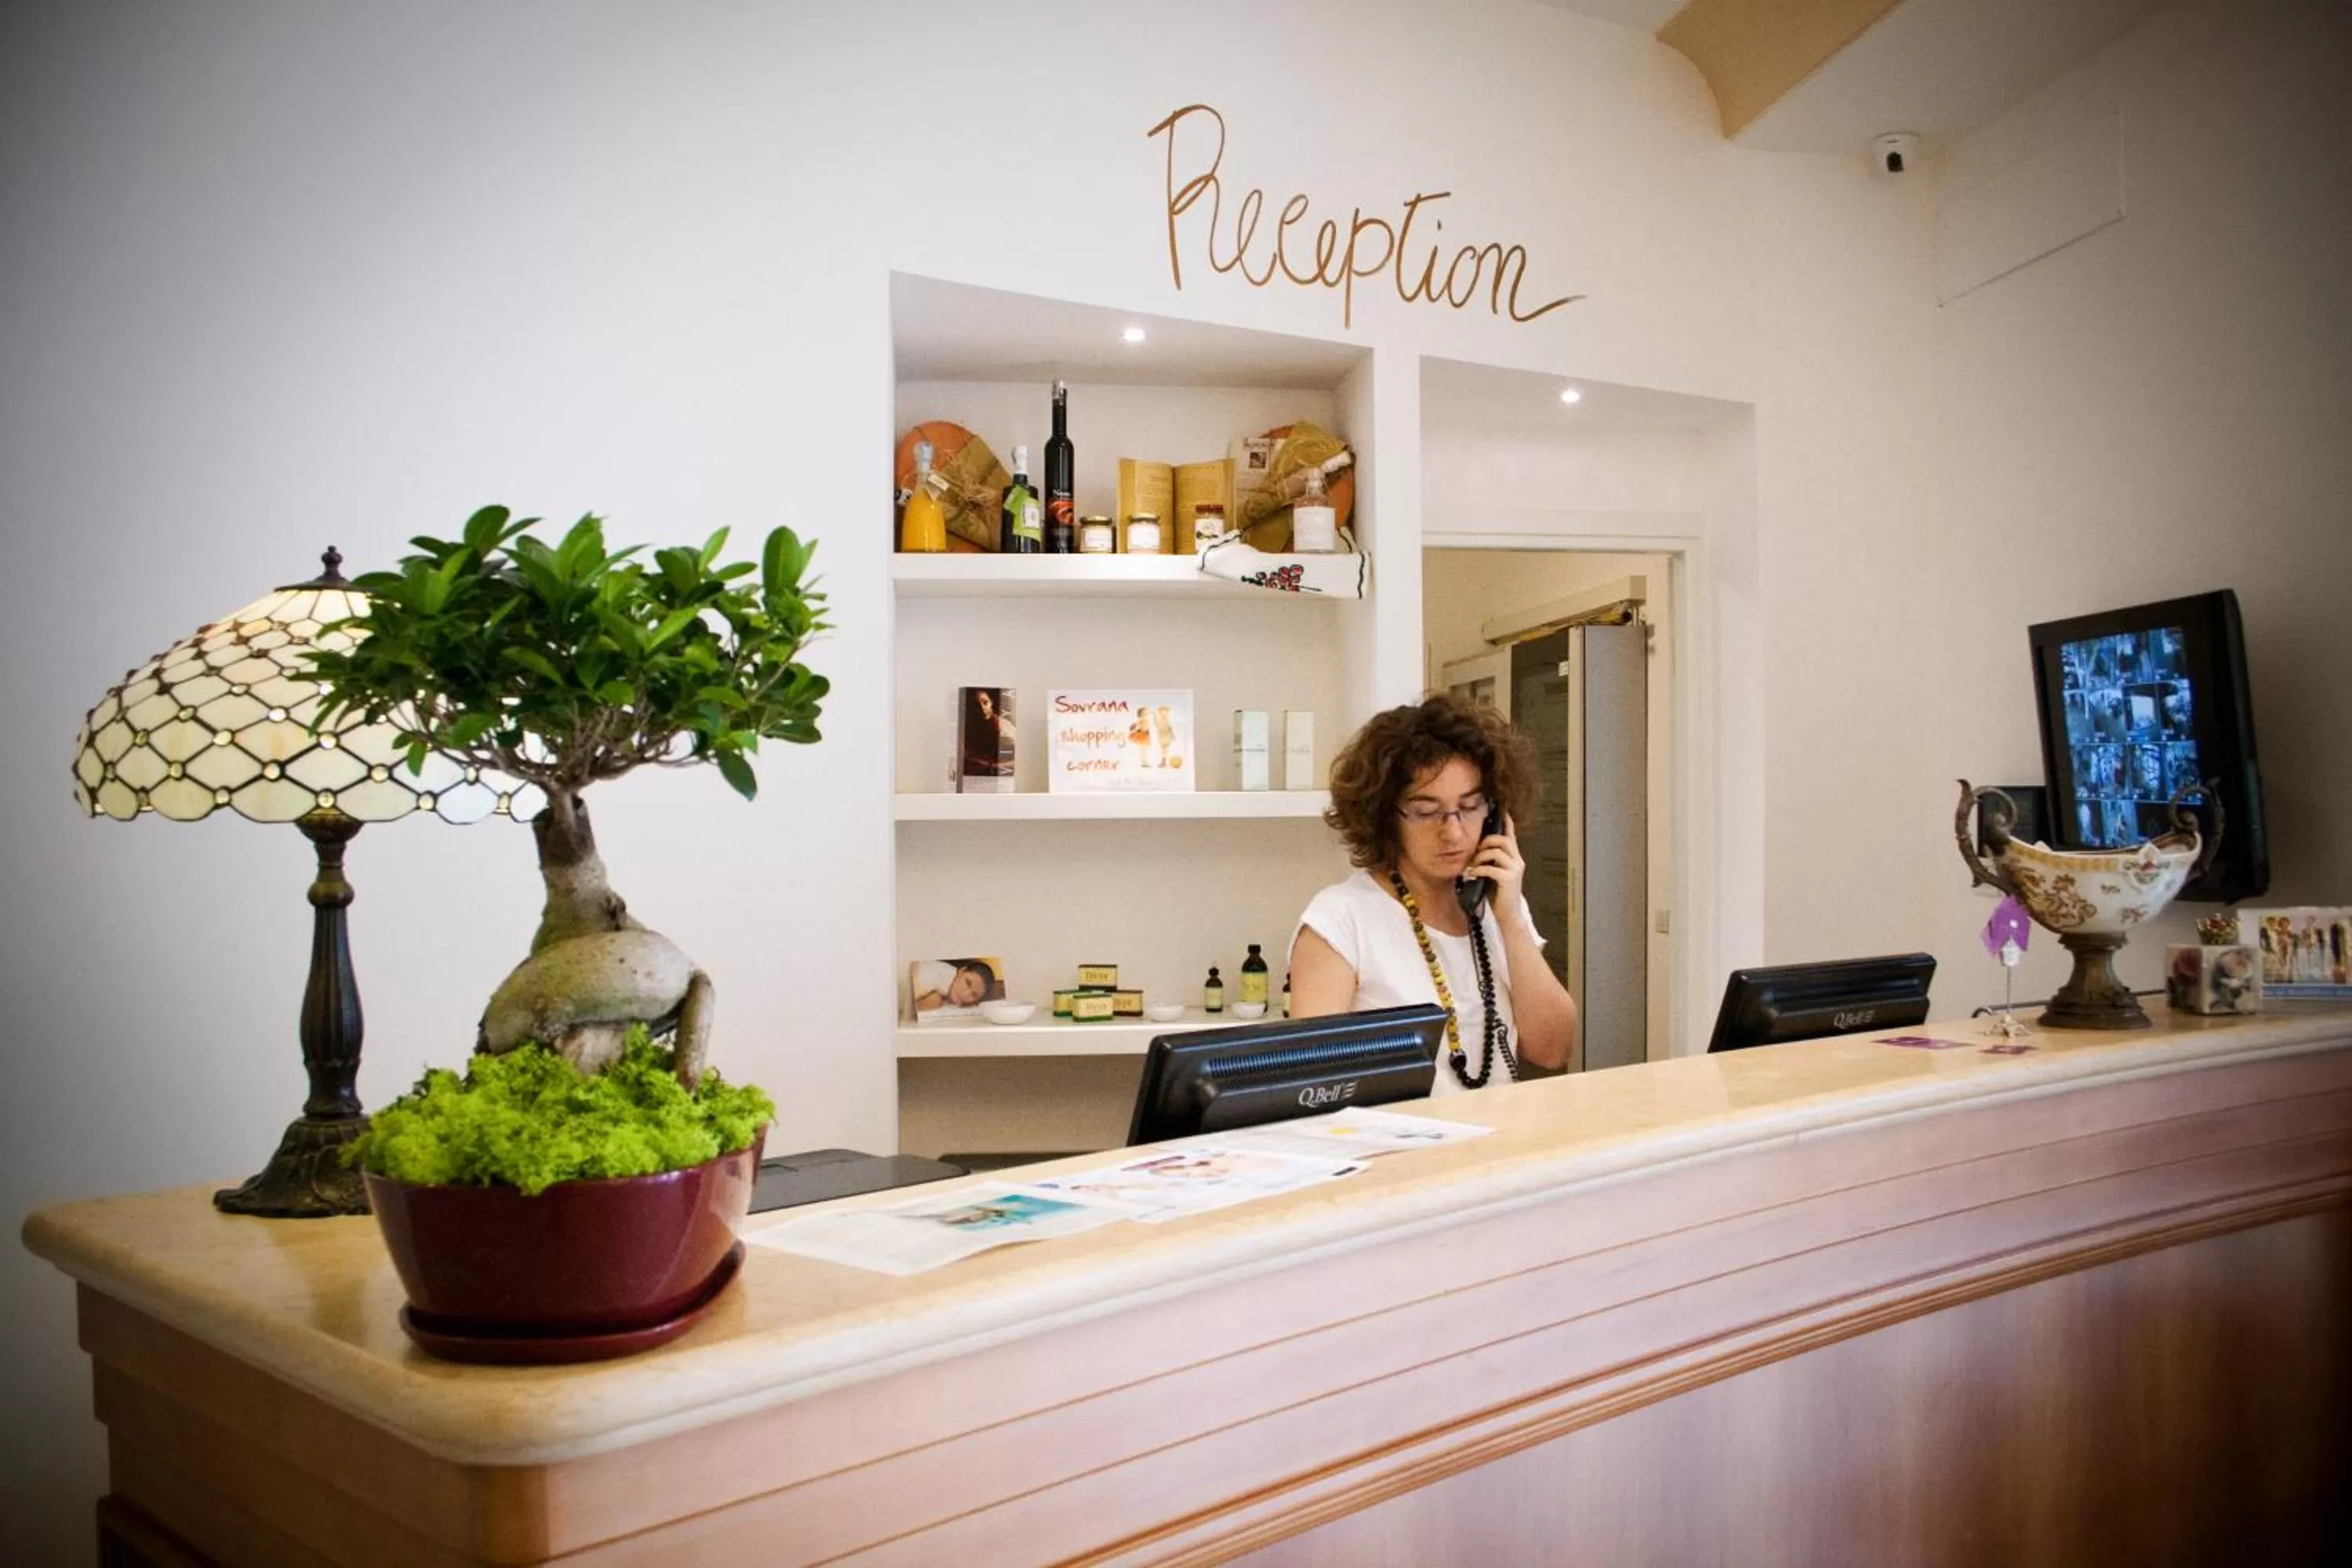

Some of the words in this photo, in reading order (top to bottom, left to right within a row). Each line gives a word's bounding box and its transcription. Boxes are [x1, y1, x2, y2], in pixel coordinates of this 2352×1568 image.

[1148, 103, 1588, 328] Reception
[1054, 695, 1129, 713] Sovrana
[1060, 727, 1127, 748] shopping
[1066, 757, 1120, 771] corner
